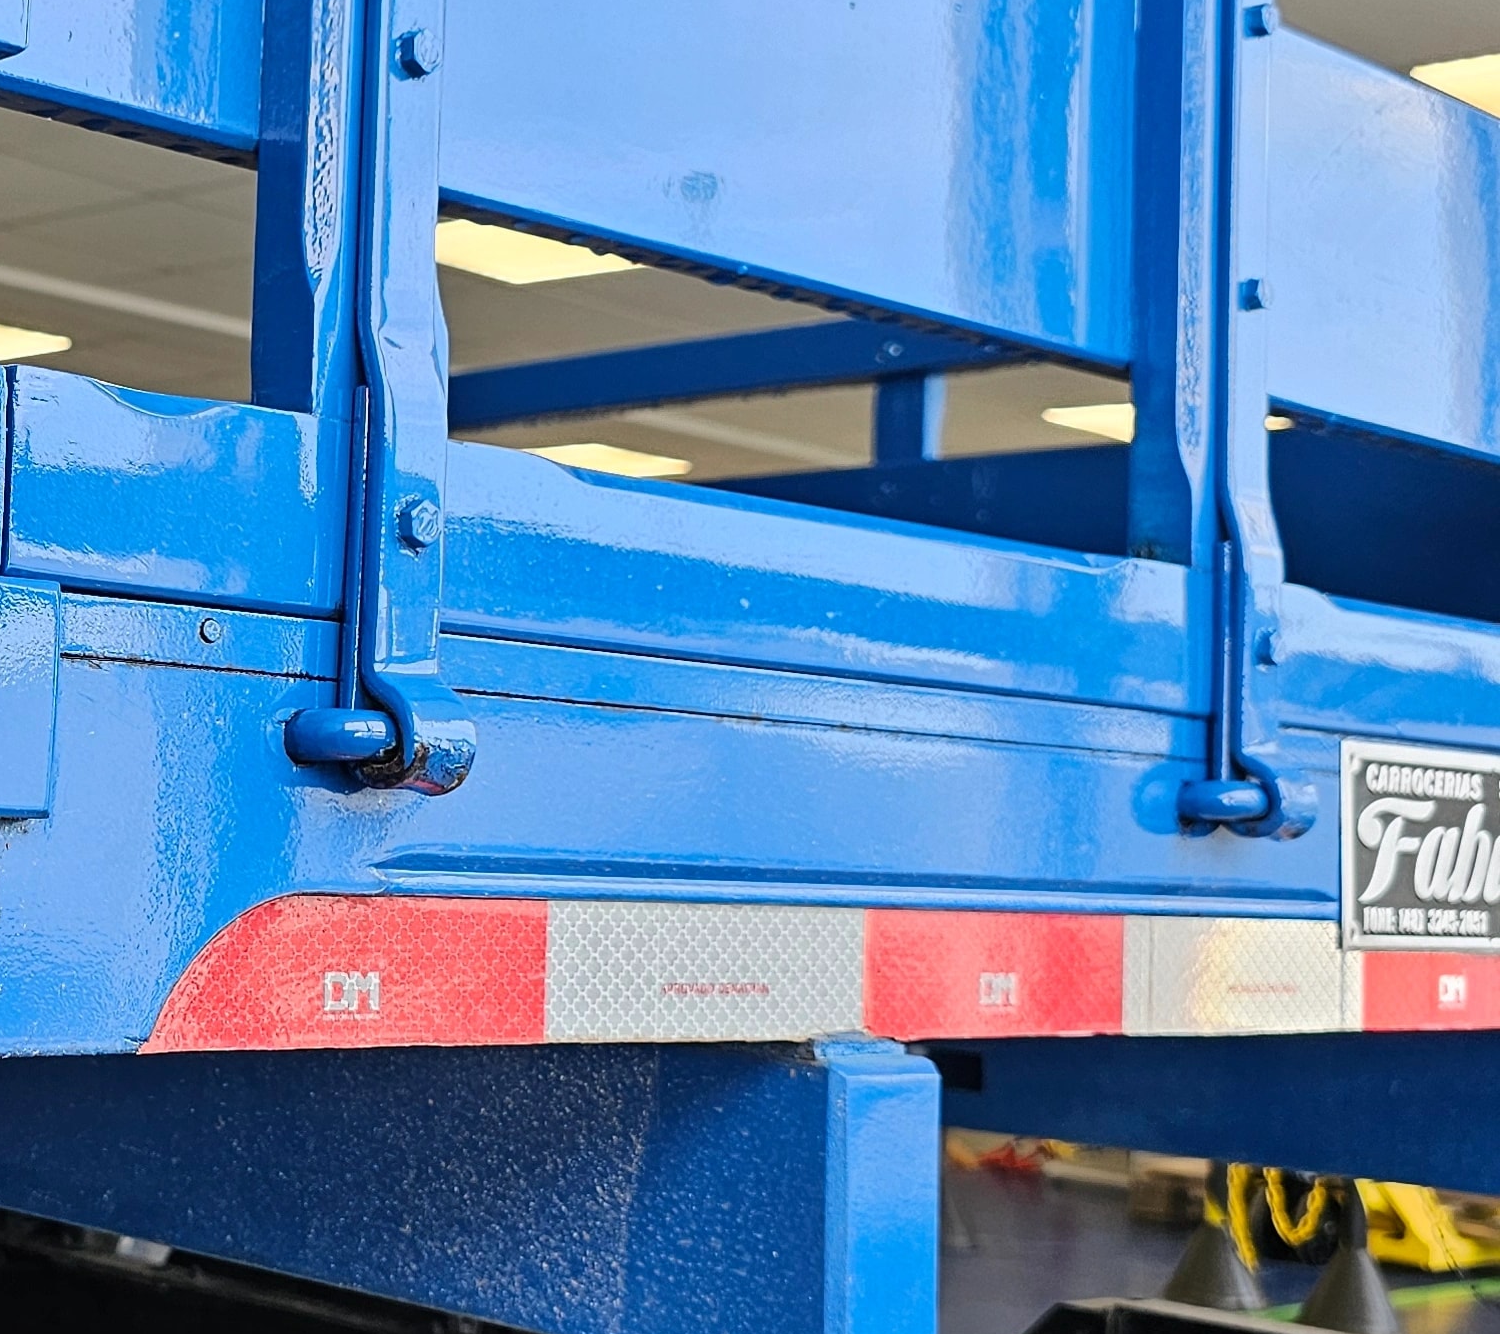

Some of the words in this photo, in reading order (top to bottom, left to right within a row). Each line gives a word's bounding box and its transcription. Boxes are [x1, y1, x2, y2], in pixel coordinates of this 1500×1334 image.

[1366, 763, 1485, 801] CARROCERIAS
[324, 971, 380, 1011] DM
[979, 972, 1017, 1007] DM
